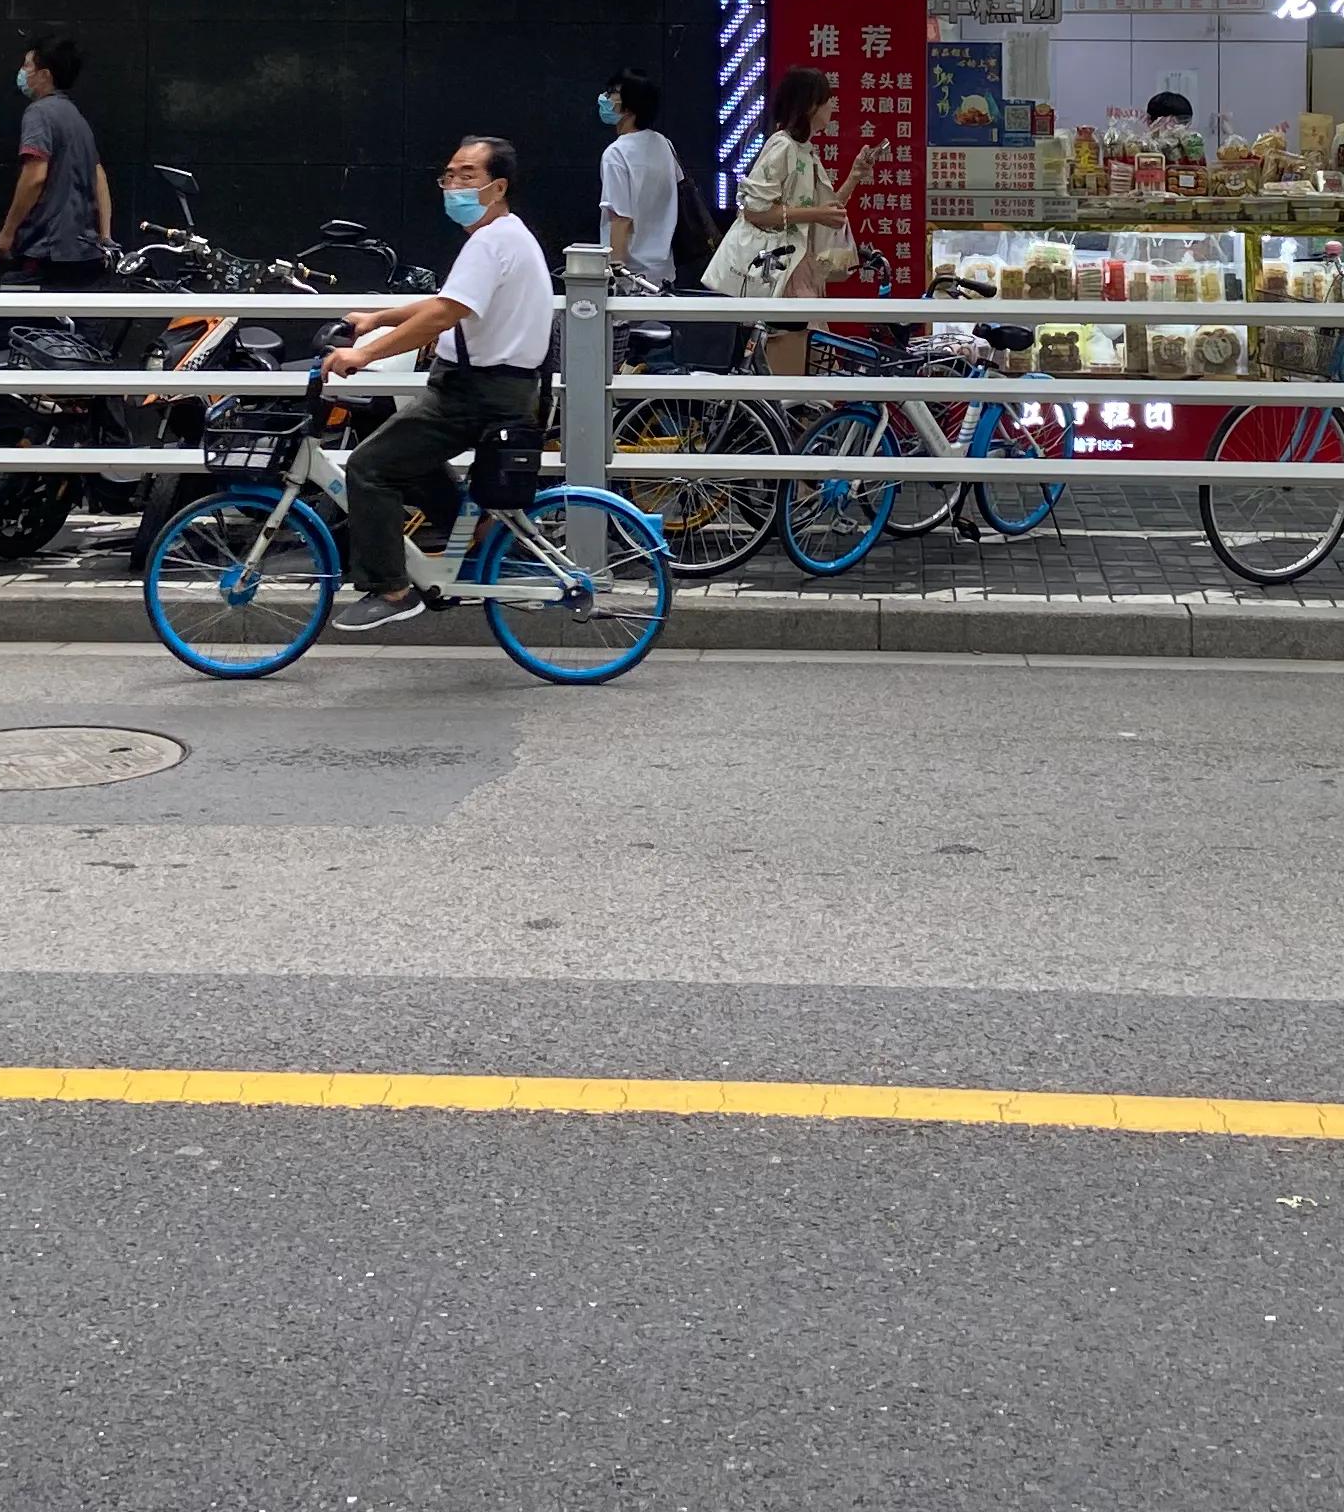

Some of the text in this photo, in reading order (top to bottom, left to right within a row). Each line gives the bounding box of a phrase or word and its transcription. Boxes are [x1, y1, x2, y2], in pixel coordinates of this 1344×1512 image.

[809, 23, 892, 59] 推荐
[860, 72, 913, 90] 条头糕
[860, 97, 912, 114] 双酿团
[859, 193, 913, 211] 水磨年糕
[859, 218, 912, 235] 八宝饭
